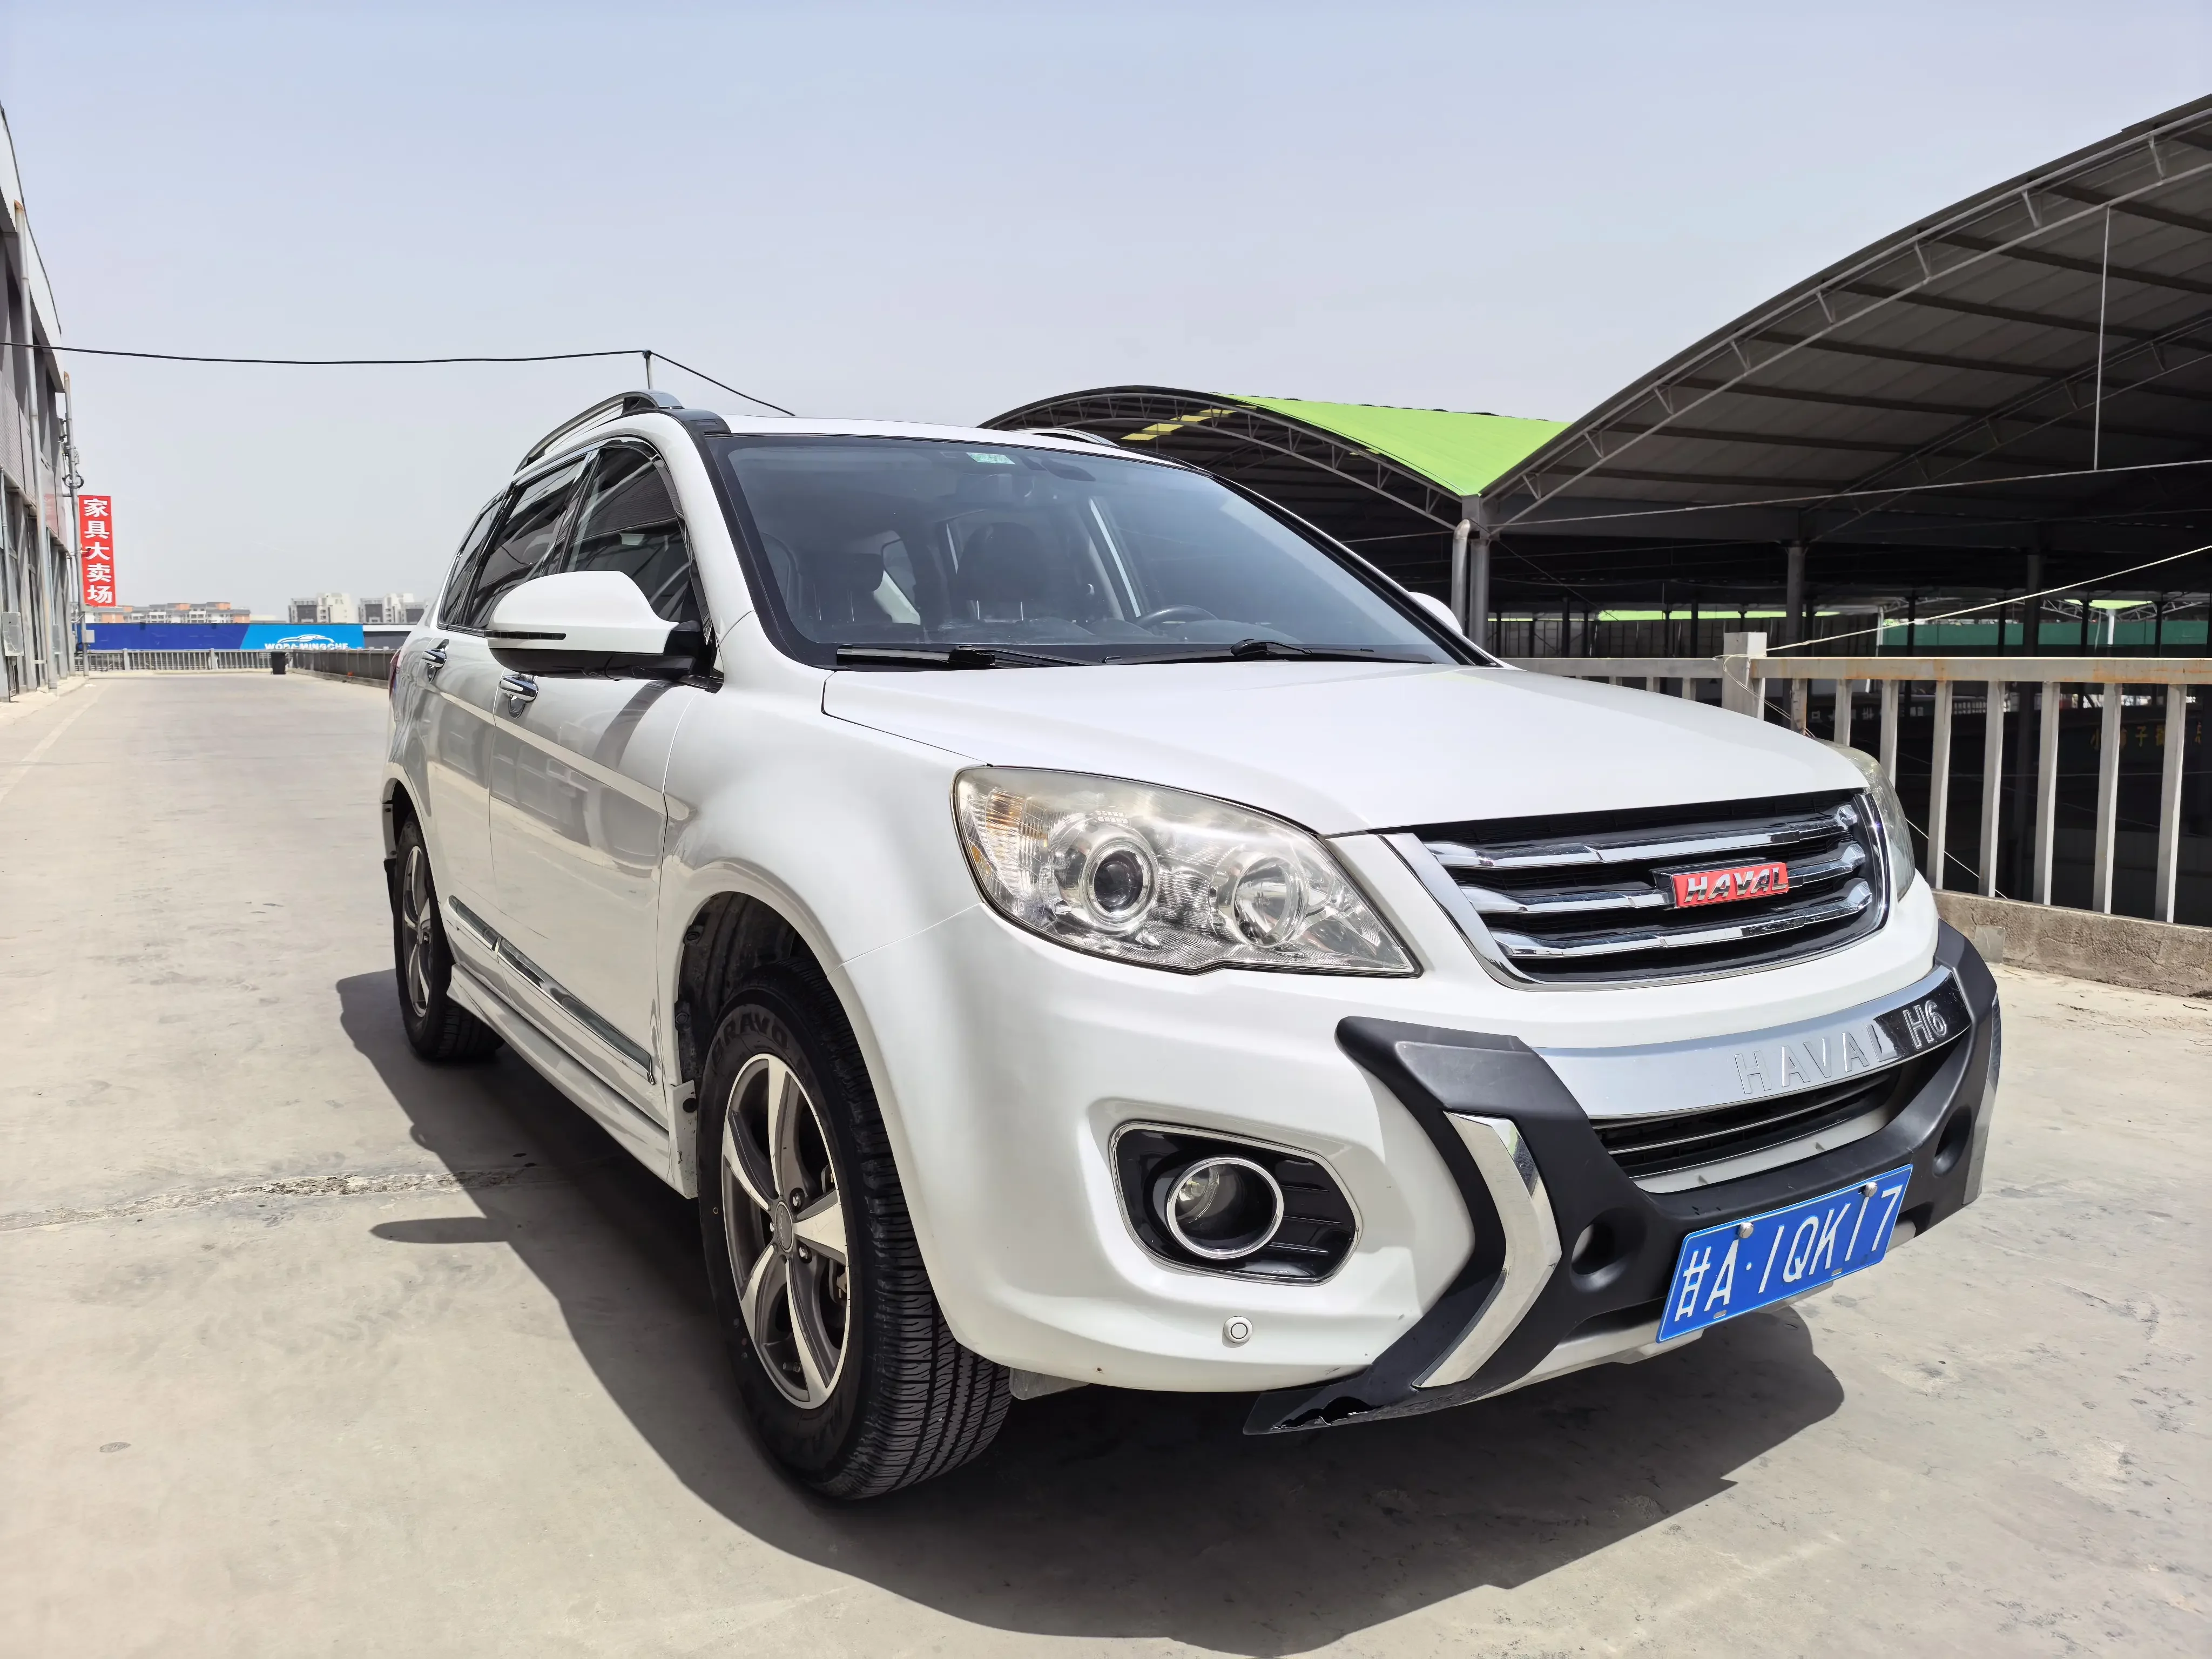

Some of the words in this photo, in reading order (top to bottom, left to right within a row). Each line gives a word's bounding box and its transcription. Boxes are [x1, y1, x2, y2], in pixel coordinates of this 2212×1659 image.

[83, 498, 112, 604] 家具大卖场
[1684, 867, 1788, 903] HAVAL
[1734, 1024, 1900, 1095] HAVAL
[1902, 1000, 1947, 1049] H6
